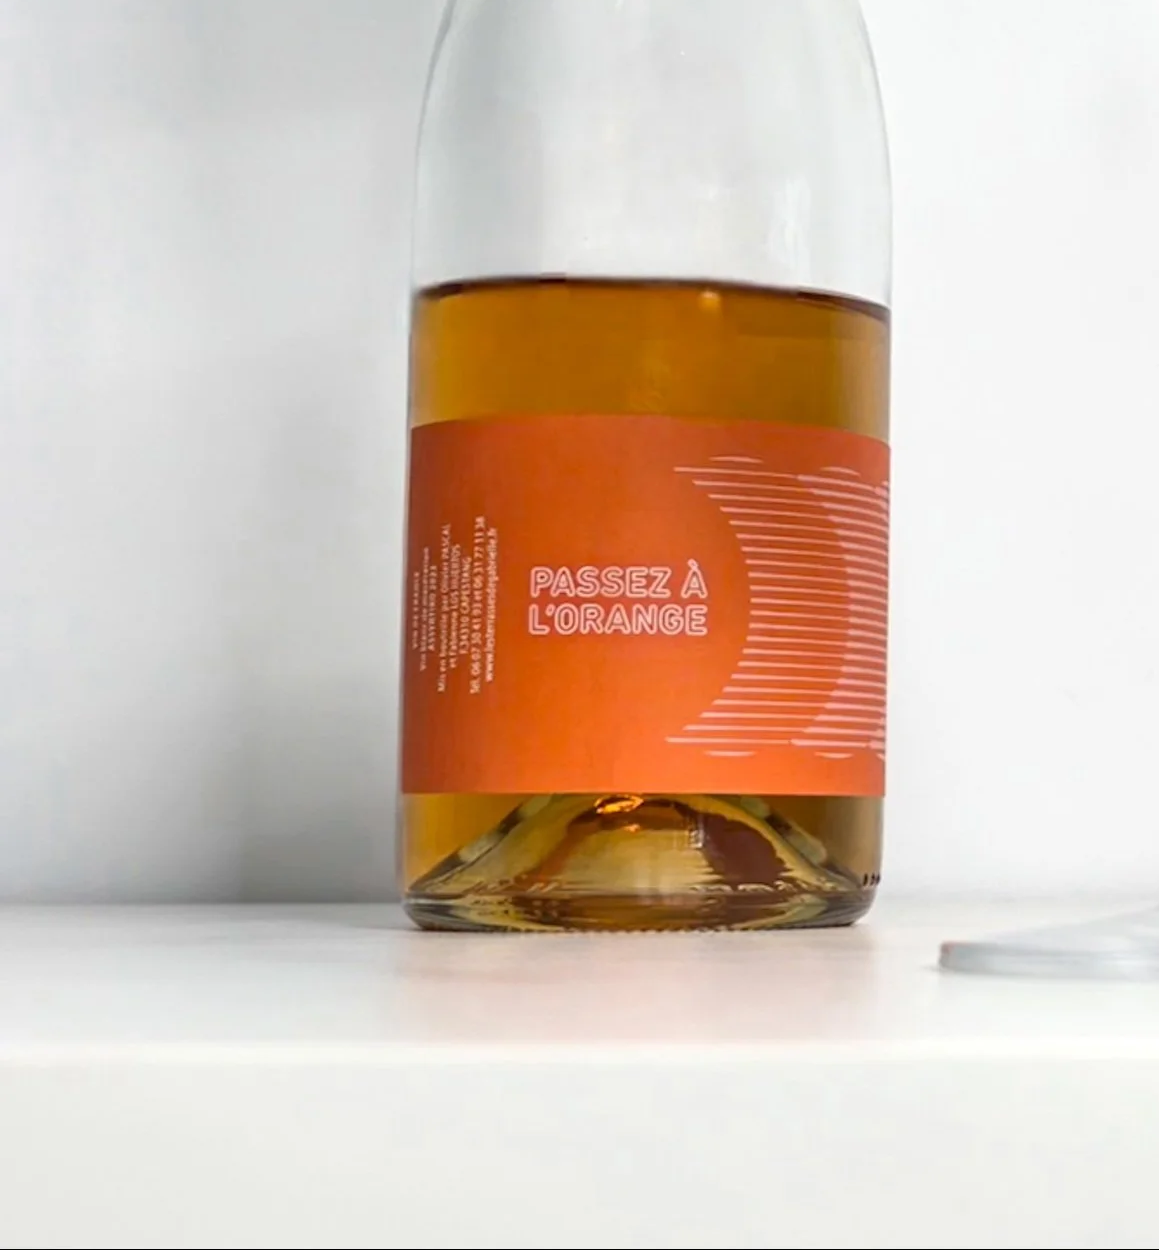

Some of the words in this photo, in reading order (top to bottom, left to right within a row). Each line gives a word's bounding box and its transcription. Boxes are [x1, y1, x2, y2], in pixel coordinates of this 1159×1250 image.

[530, 565, 672, 598] PASSEZ
[680, 558, 708, 599] À
[528, 603, 708, 636] L'ORANGE
